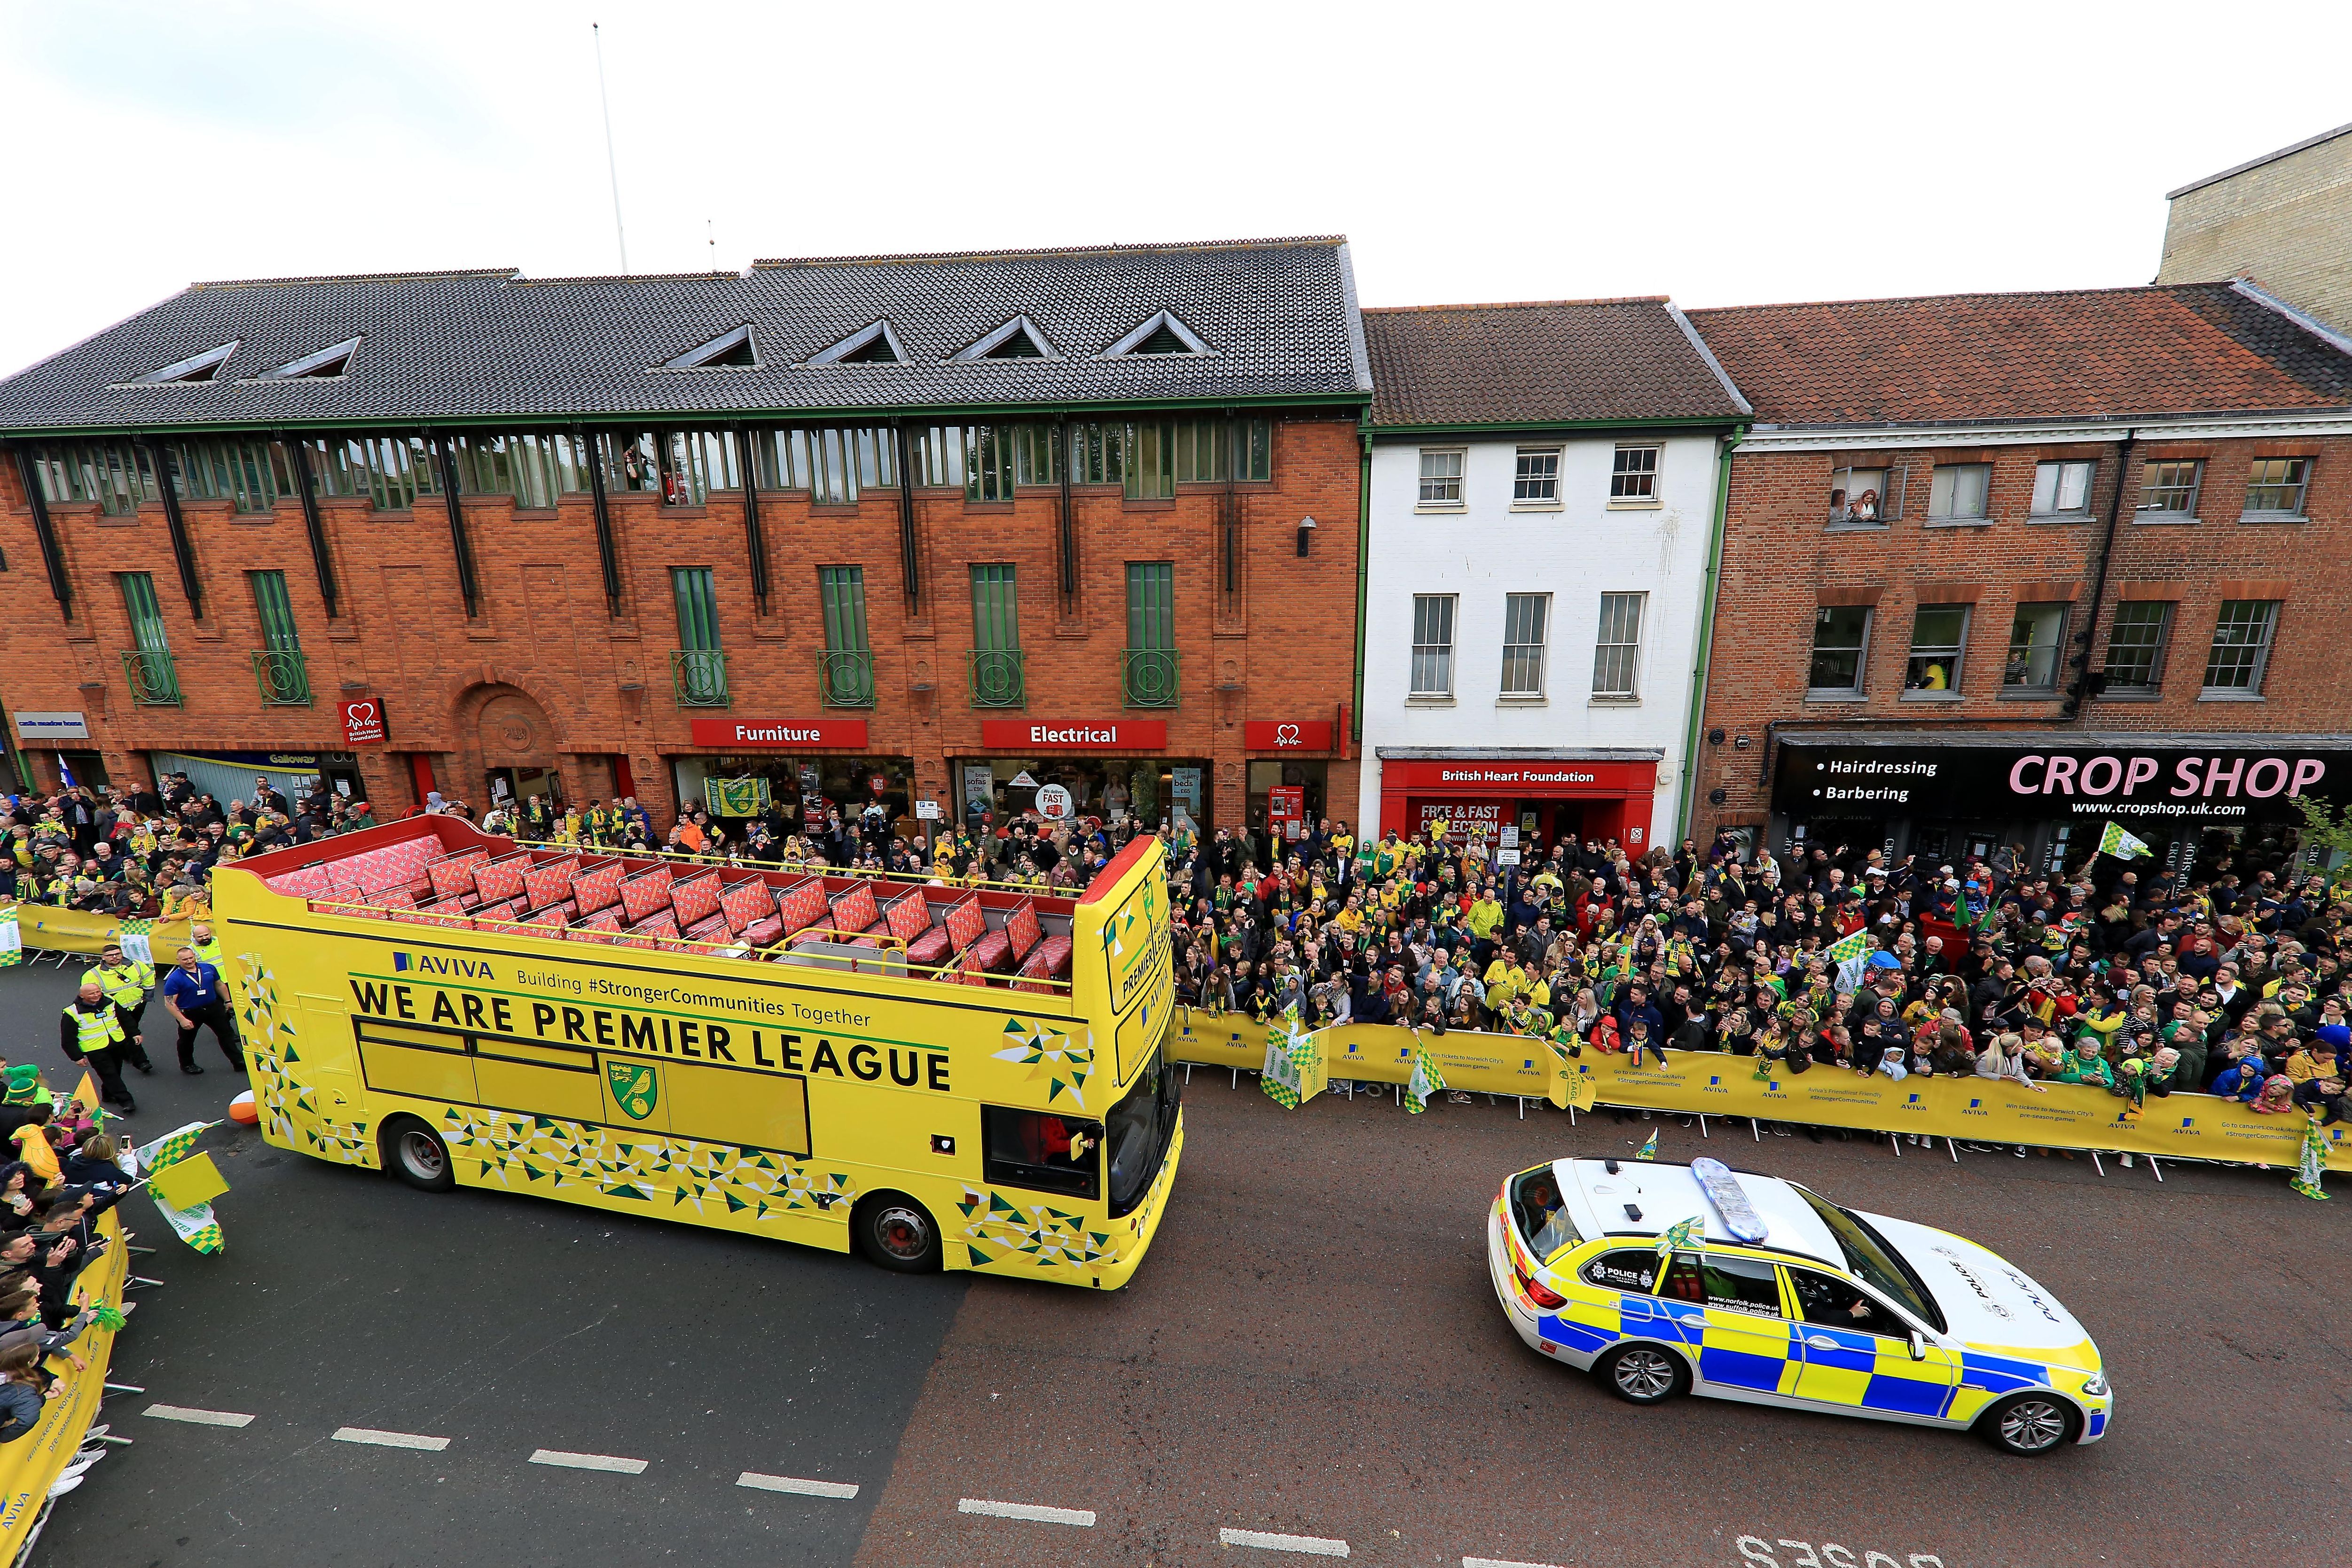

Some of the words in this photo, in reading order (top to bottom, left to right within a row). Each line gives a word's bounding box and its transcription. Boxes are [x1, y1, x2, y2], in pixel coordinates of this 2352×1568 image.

[350, 733, 382, 742] Foundation
[736, 725, 820, 742] Furniture
[1030, 726, 1116, 743] Electrical
[269, 754, 315, 763] Galloway
[1442, 770, 1482, 781] British
[1484, 770, 1519, 781] Heart
[1522, 771, 1594, 782] Foundation
[1830, 761, 1937, 776] Hairdressing
[2010, 755, 2158, 796] CROP
[2171, 757, 2325, 798] SHOP
[1043, 794, 1064, 803] FAST
[1826, 787, 1909, 802] Barbering
[1455, 806, 1466, 818] &
[1468, 806, 1500, 818] FAST
[2071, 800, 2246, 817] www.cropshop.uk.com
[1883, 839, 1895, 865] CROP
[2182, 843, 2195, 871] SHOP
[2307, 844, 2319, 866] CRO
[1145, 932, 1151, 947] WE
[1122, 949, 1153, 1000] PREMIER
[419, 956, 494, 980] AVIVA
[517, 970, 581, 994] Building
[589, 977, 784, 1016] #StrongerCommunities
[792, 1003, 871, 1027] Together
[1150, 968, 1168, 1011] AVIVA
[350, 979, 416, 1020] WE
[431, 990, 514, 1032] ARE
[532, 1002, 737, 1062] PREMIER
[752, 1030, 950, 1092] LEAGUE
[1128, 1045, 1143, 1068] Building
[1617, 1077, 1681, 1088] #StrongerCommunities
[1629, 1071, 1686, 1080] canaries.co.uk/Aviva
[1810, 1094, 1878, 1105] #StrongerCommunities
[2020, 1113, 2054, 1121] pre-season
[2049, 1107, 2076, 1115] Norwich
[2077, 1109, 2094, 1118] City's
[2226, 1131, 2296, 1141] #StrongerCommunities
[2239, 1123, 2305, 1134] canaries.co.uk/Aviva
[1607, 1268, 1638, 1279] POLICE
[1949, 1261, 1989, 1299] POLICE
[1708, 1296, 1780, 1311] www.norfolk.police.uk
[2001, 1269, 2061, 1323] POLICE
[1708, 1301, 1779, 1317] www.suffolk.police.uk
[37, 1422, 54, 1447] tickets
[53, 1412, 60, 1421] to
[59, 1381, 78, 1411] Norwich
[2, 1492, 30, 1530] AVIVA
